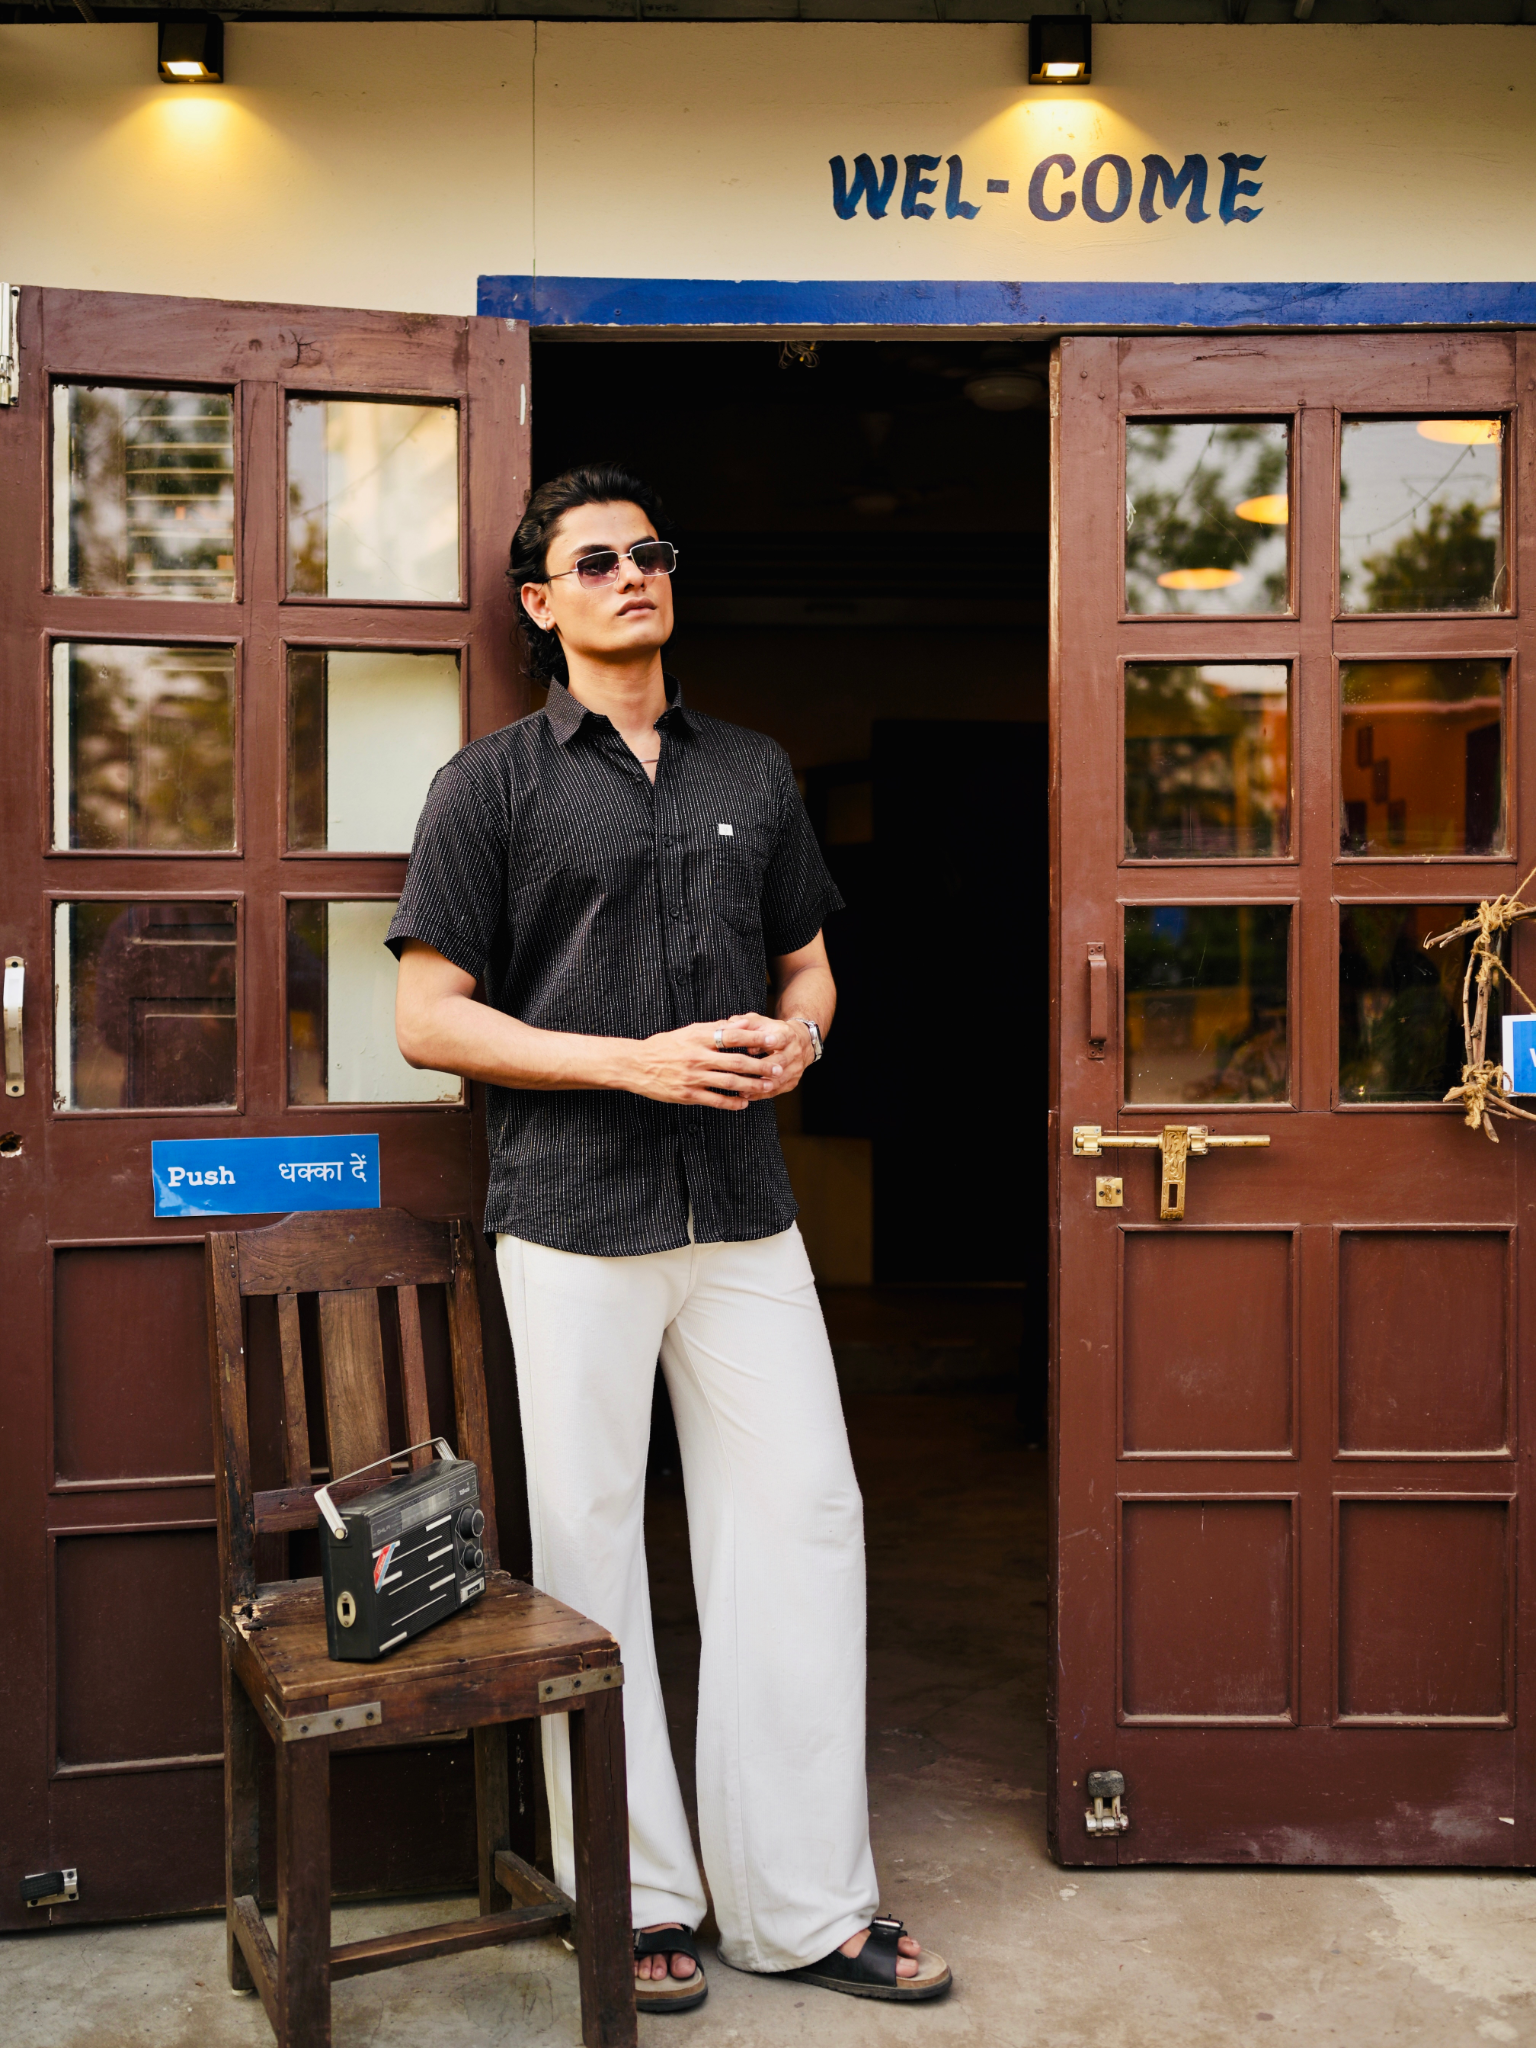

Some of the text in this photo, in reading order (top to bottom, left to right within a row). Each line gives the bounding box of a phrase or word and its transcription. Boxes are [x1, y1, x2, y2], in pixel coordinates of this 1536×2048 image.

[829, 152, 1268, 226] WEL-COME
[167, 1165, 236, 1188] Push
[278, 1152, 368, 1183] धक्का दें
